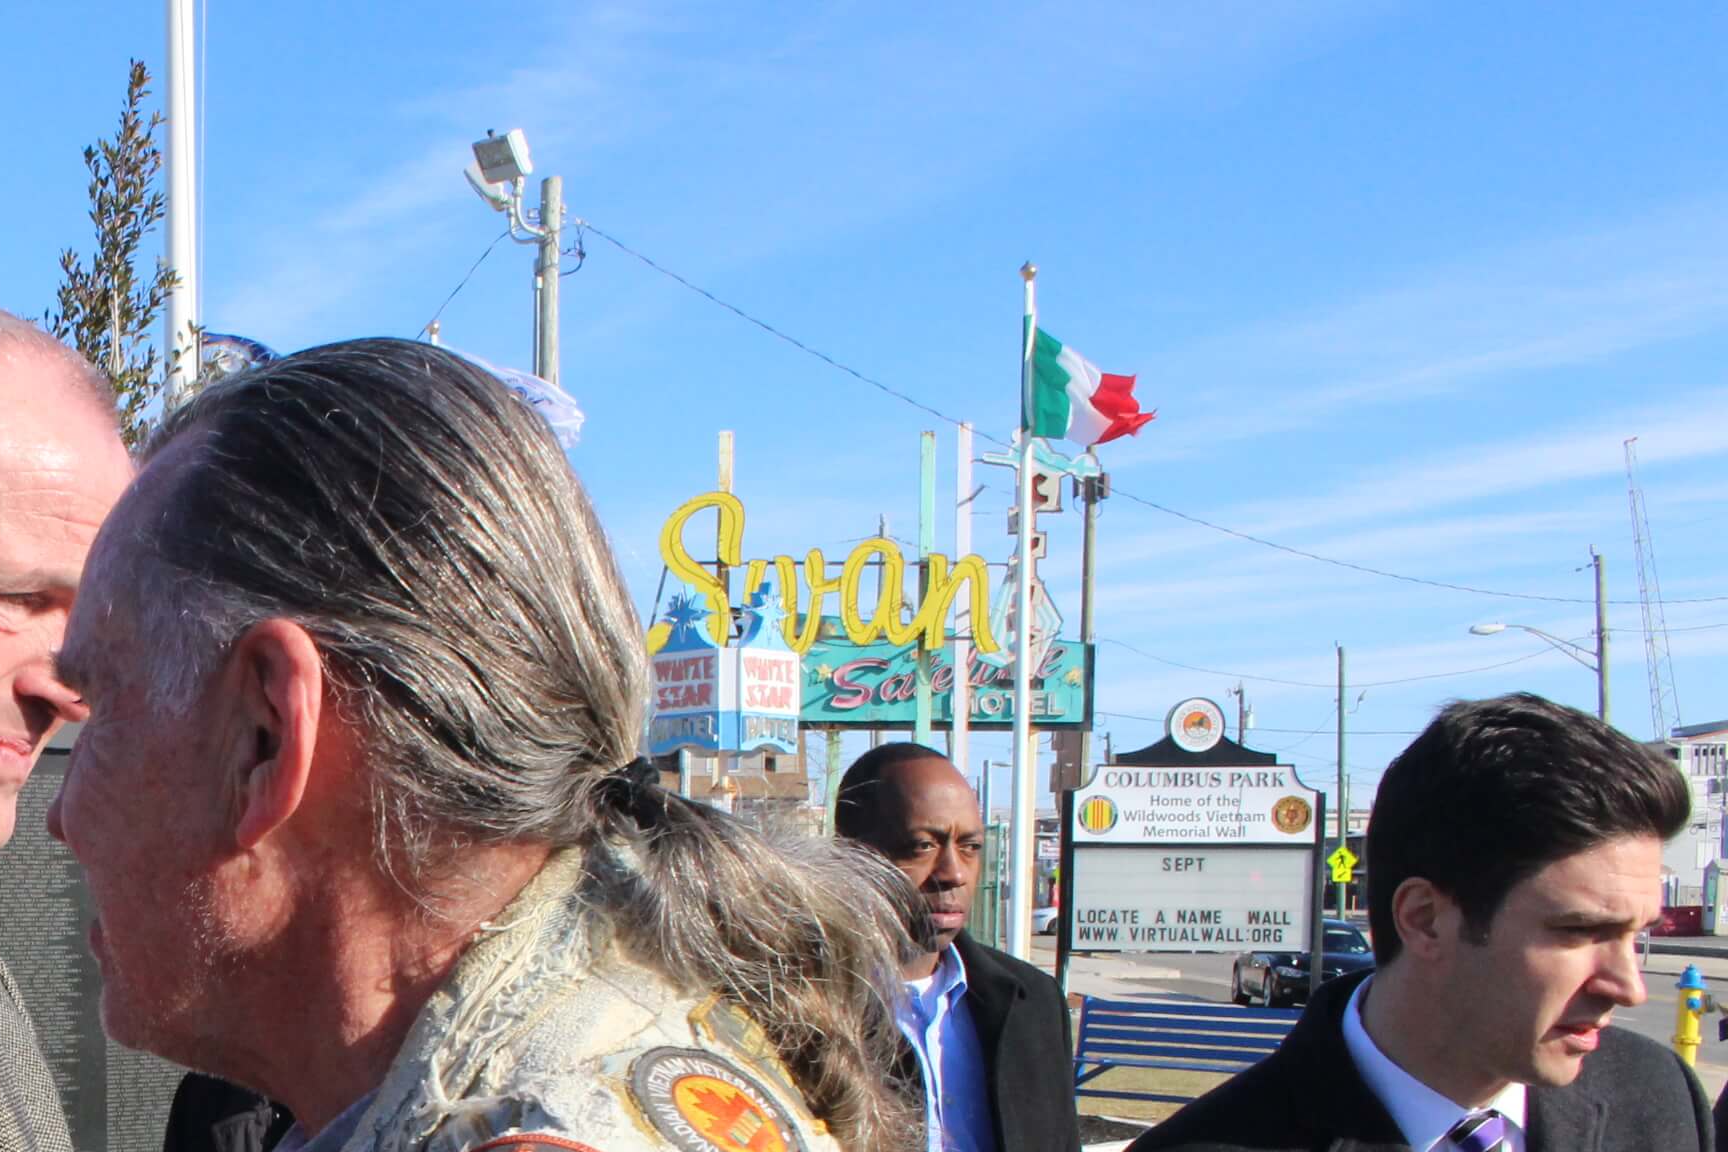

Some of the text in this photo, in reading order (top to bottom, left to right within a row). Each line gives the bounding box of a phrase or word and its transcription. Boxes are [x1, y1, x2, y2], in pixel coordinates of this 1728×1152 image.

[647, 491, 1001, 656] Swan
[654, 656, 714, 682] WHITE
[743, 656, 795, 684] WHITE
[655, 682, 713, 710] STAR
[744, 683, 794, 710] STAR
[1103, 770, 1286, 788] COLUMBUS PARK
[1149, 794, 1241, 807] Home of the
[1122, 809, 1266, 823] Wildwoods Vietnam
[1142, 825, 1246, 838] Memorial Wall
[1161, 857, 1206, 872] SEPT
[1077, 909, 1291, 926] LOCATE A NAME WALL
